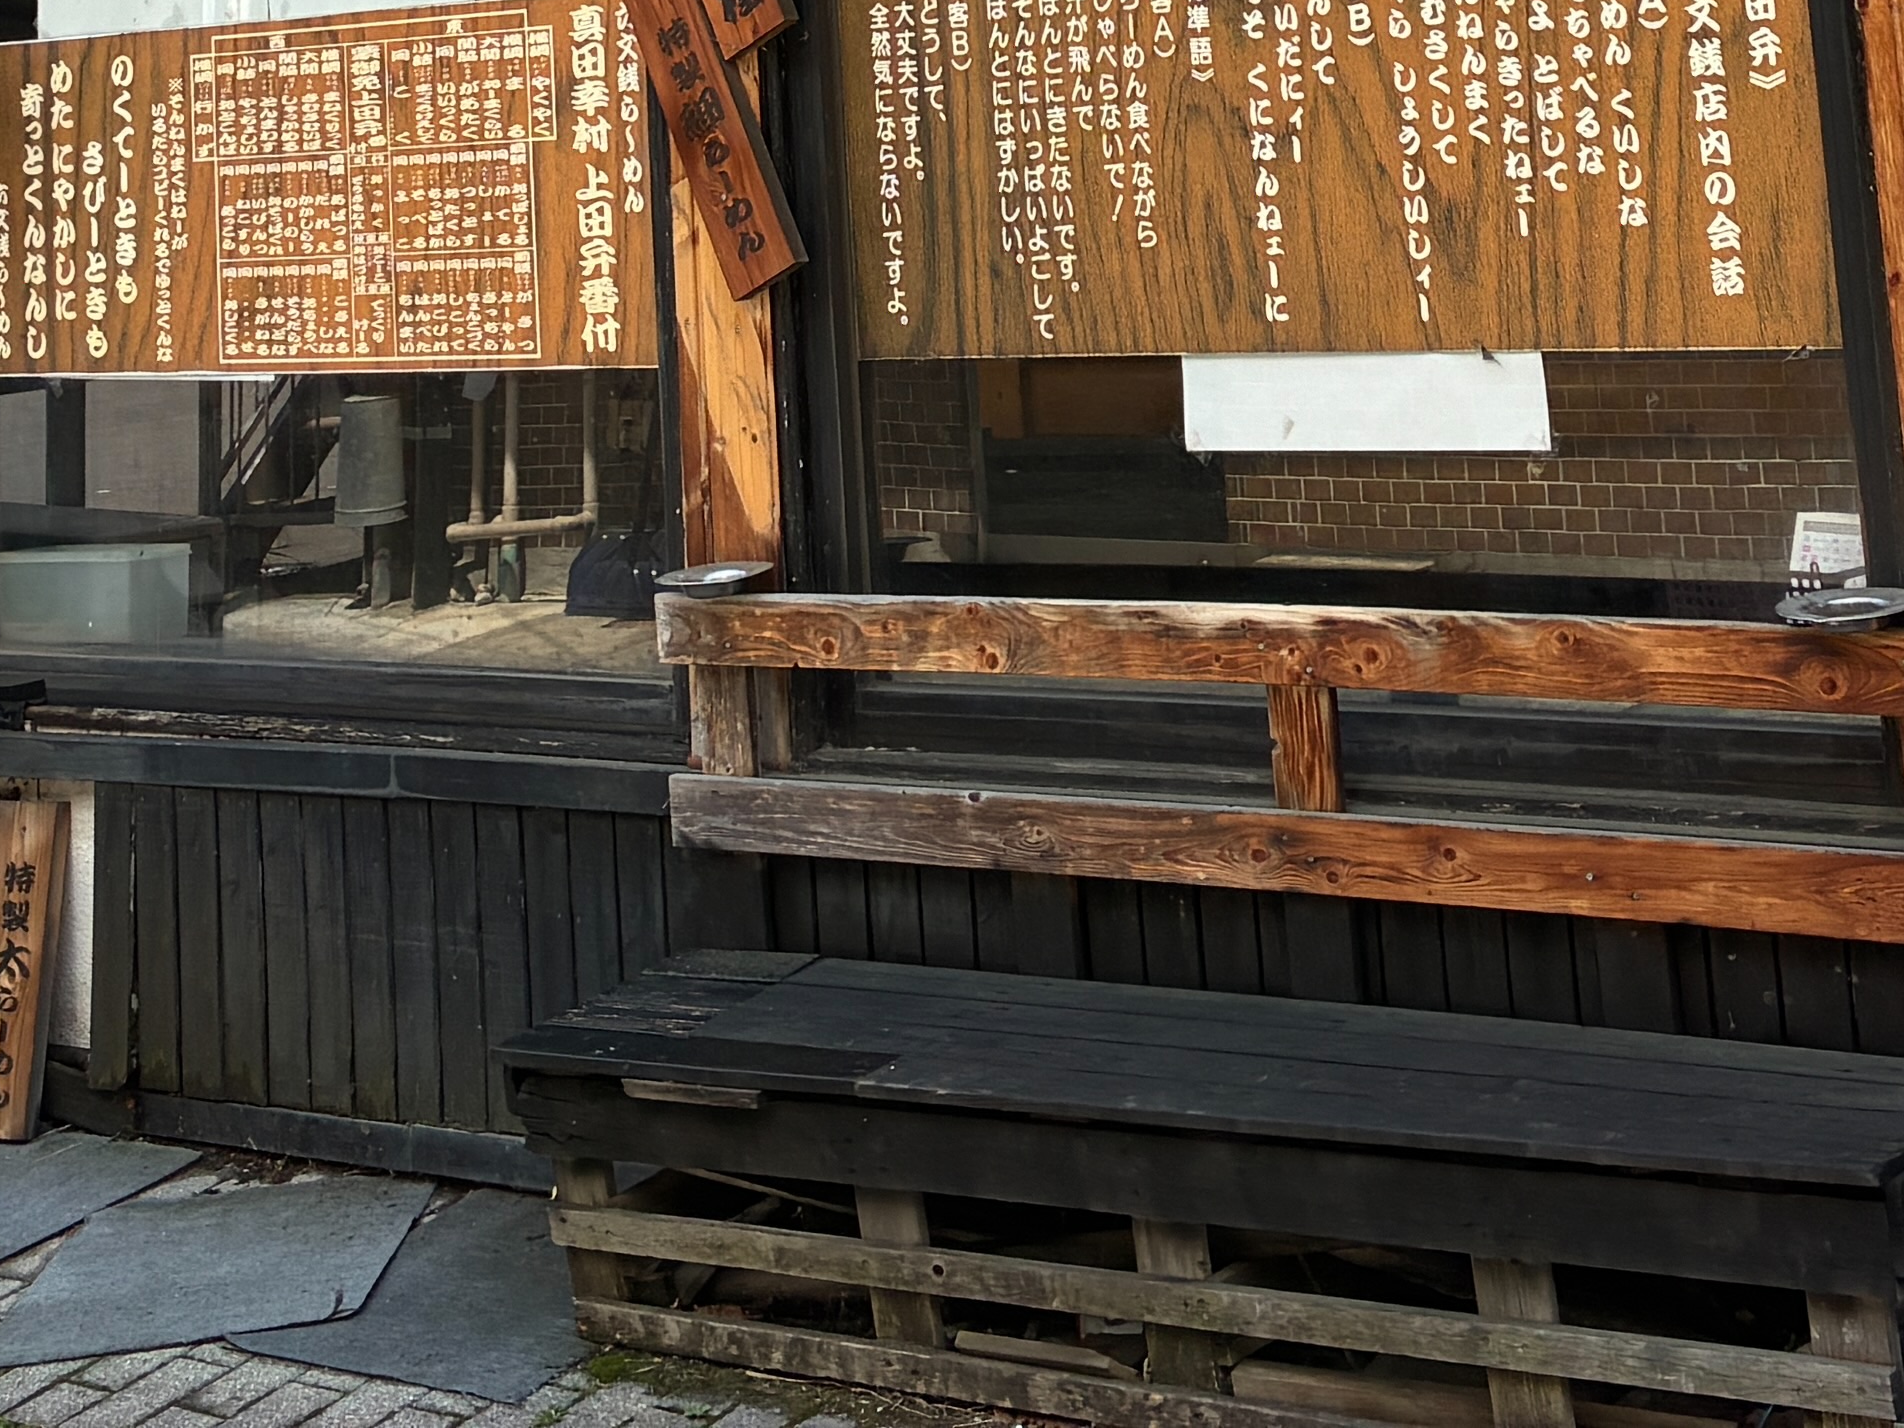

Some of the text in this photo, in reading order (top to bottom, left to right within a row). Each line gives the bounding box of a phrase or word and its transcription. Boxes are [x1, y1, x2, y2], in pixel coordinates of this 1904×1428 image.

[111, 54, 138, 304] のくてーときも
[569, 5, 621, 354] 真田幸村 上田弁番付
[868, 3, 910, 326] 全然気にならないですよ。
[894, 1, 925, 181] 大丈夫ですよ。
[1533, 54, 1568, 191] とばして
[1610, 89, 1648, 227] くいしな
[82, 141, 108, 358] さびーときも
